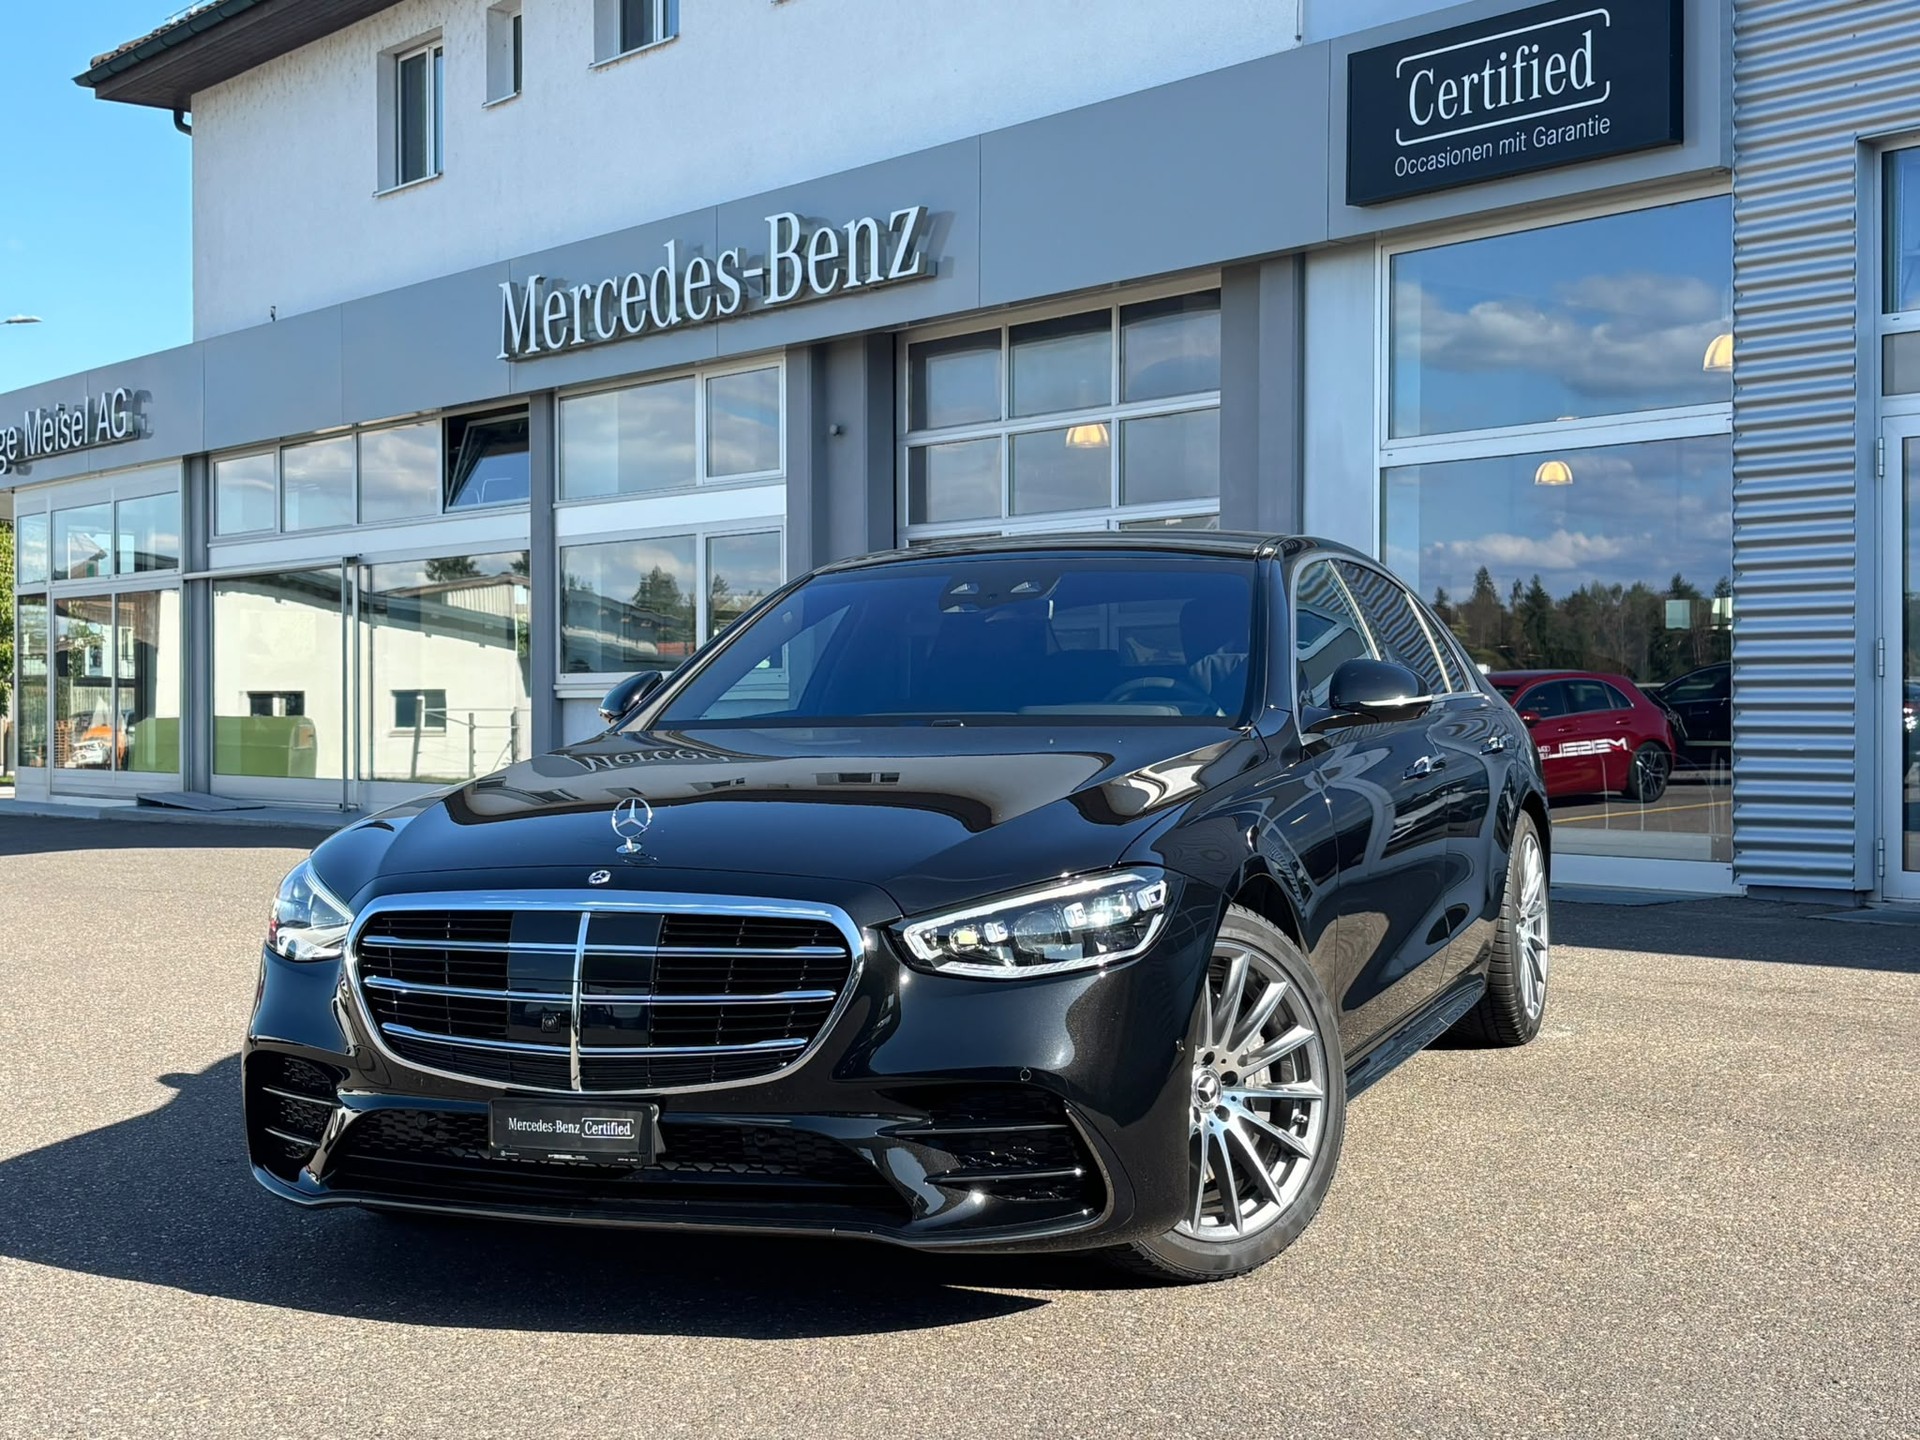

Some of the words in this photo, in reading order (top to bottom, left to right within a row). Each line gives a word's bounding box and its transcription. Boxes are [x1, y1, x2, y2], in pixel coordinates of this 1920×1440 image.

[1408, 30, 1595, 126] Certified
[1395, 143, 1493, 178] Occasionen
[1499, 132, 1527, 156] mit
[1533, 114, 1611, 148] Garantie
[496, 205, 922, 360] Mercedes-Benz
[24, 395, 90, 457] Meisel
[95, 387, 128, 443] AG
[508, 1117, 580, 1134] Mercedes-Benz
[585, 1121, 631, 1136] Certified
